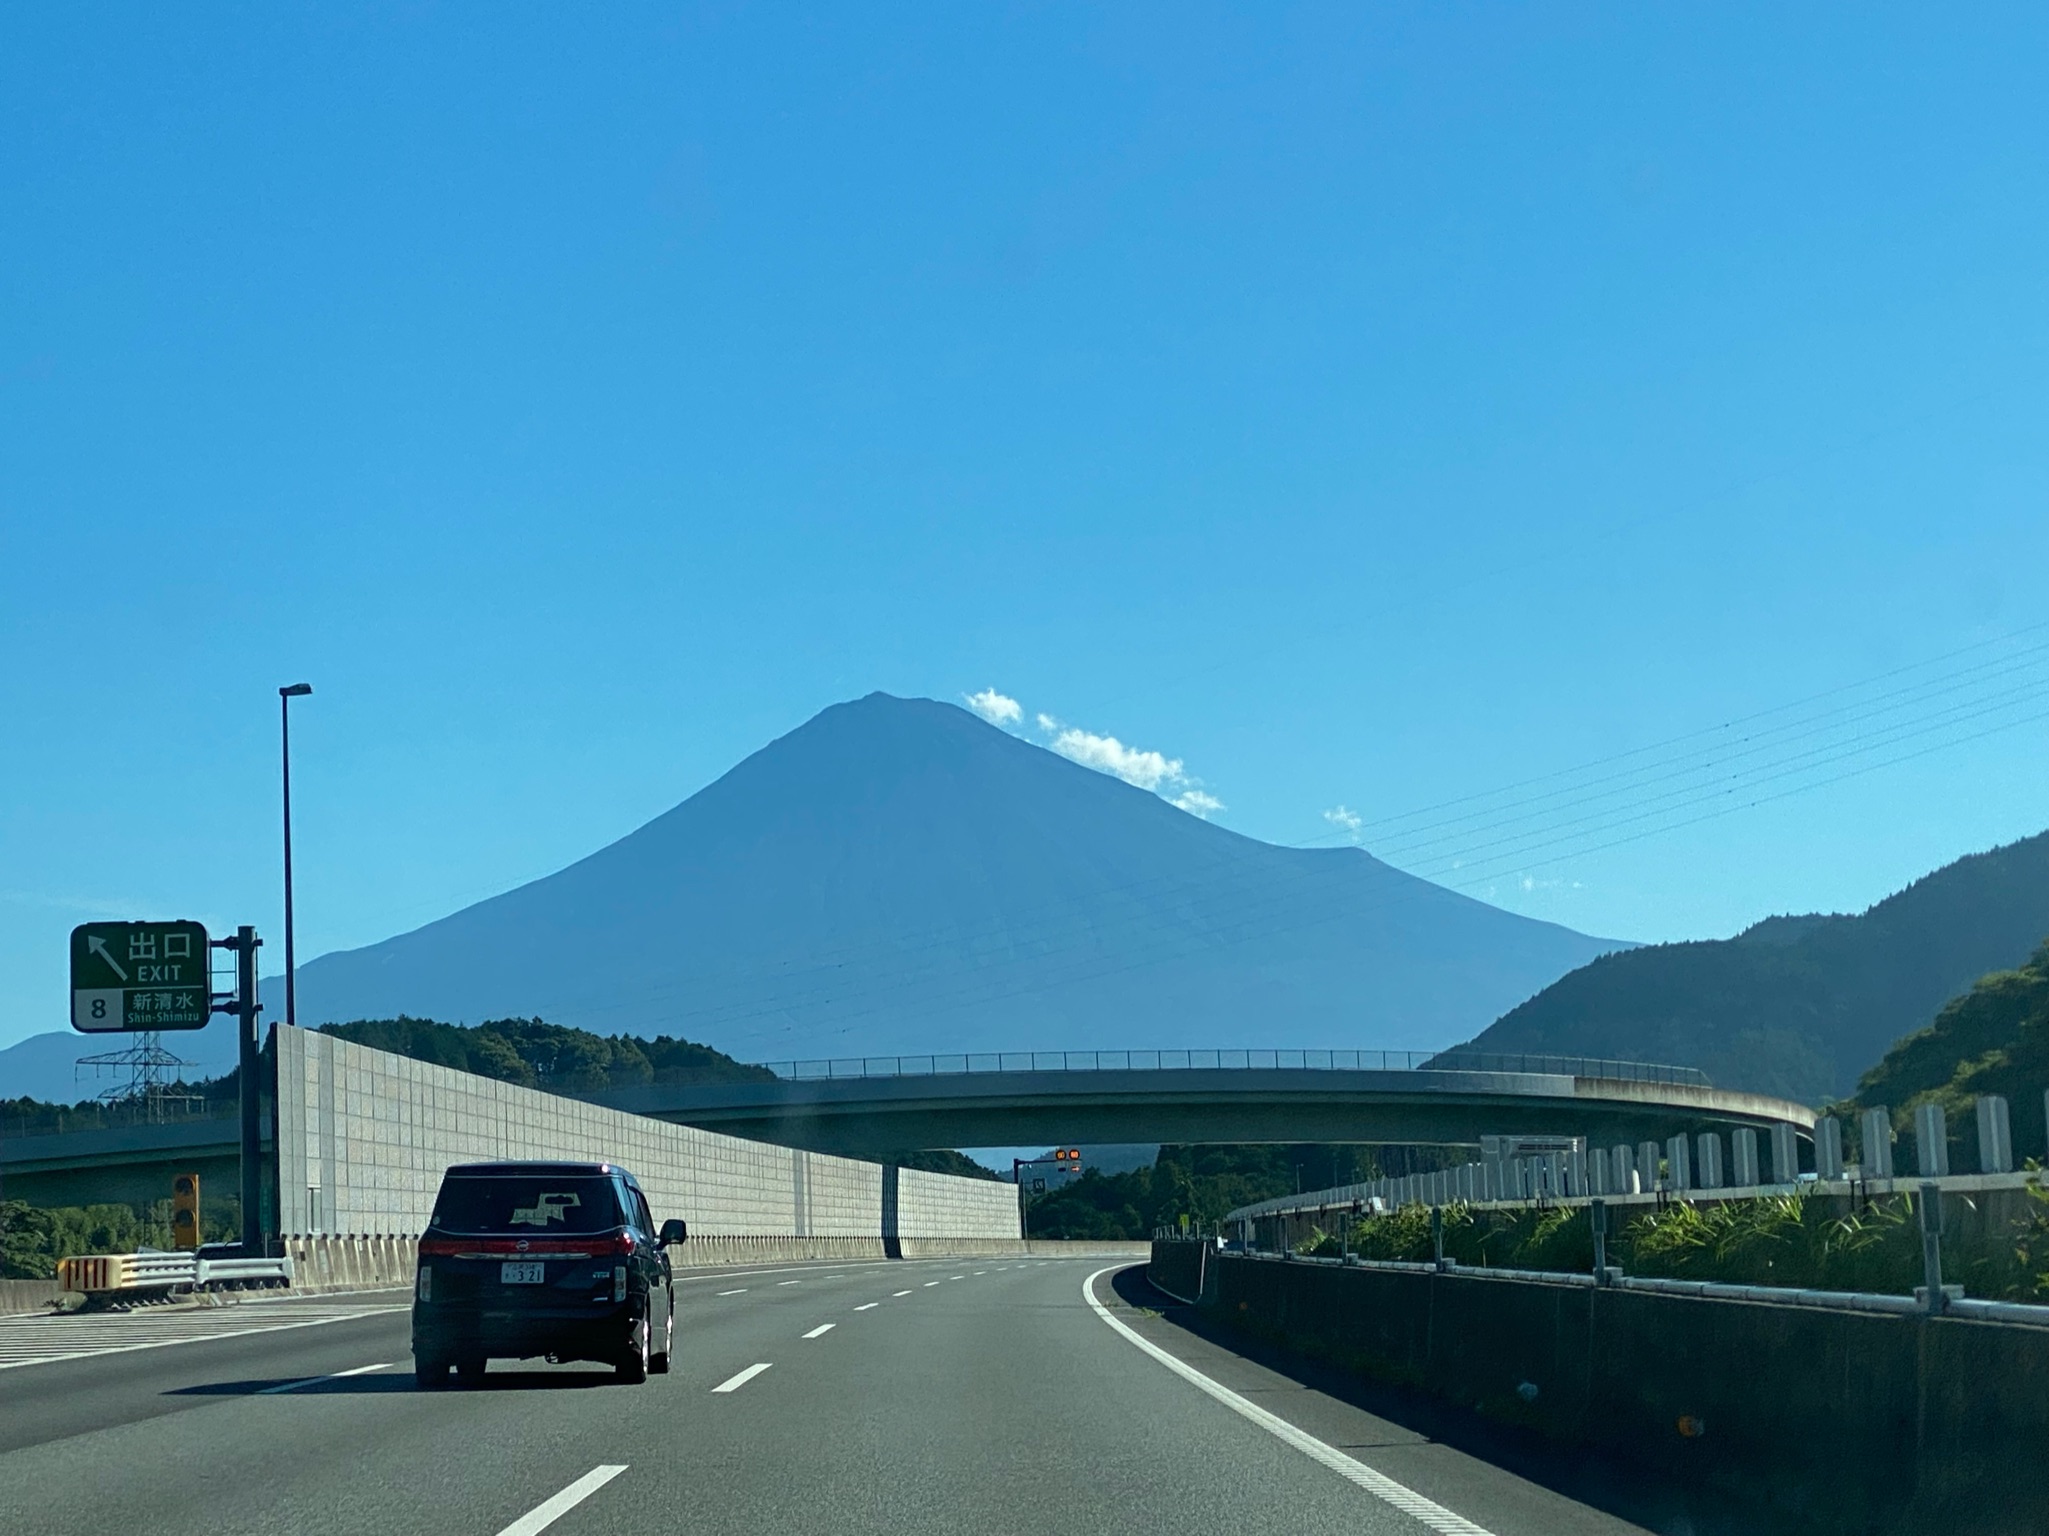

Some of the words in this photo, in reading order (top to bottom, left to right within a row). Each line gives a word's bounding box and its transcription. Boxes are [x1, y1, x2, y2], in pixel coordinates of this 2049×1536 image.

[129, 932, 191, 960] 出口
[137, 965, 182, 982] EXIT
[91, 999, 106, 1019] 8
[132, 992, 194, 1011] 新清水
[127, 1010, 200, 1024] Shin-Shimizu
